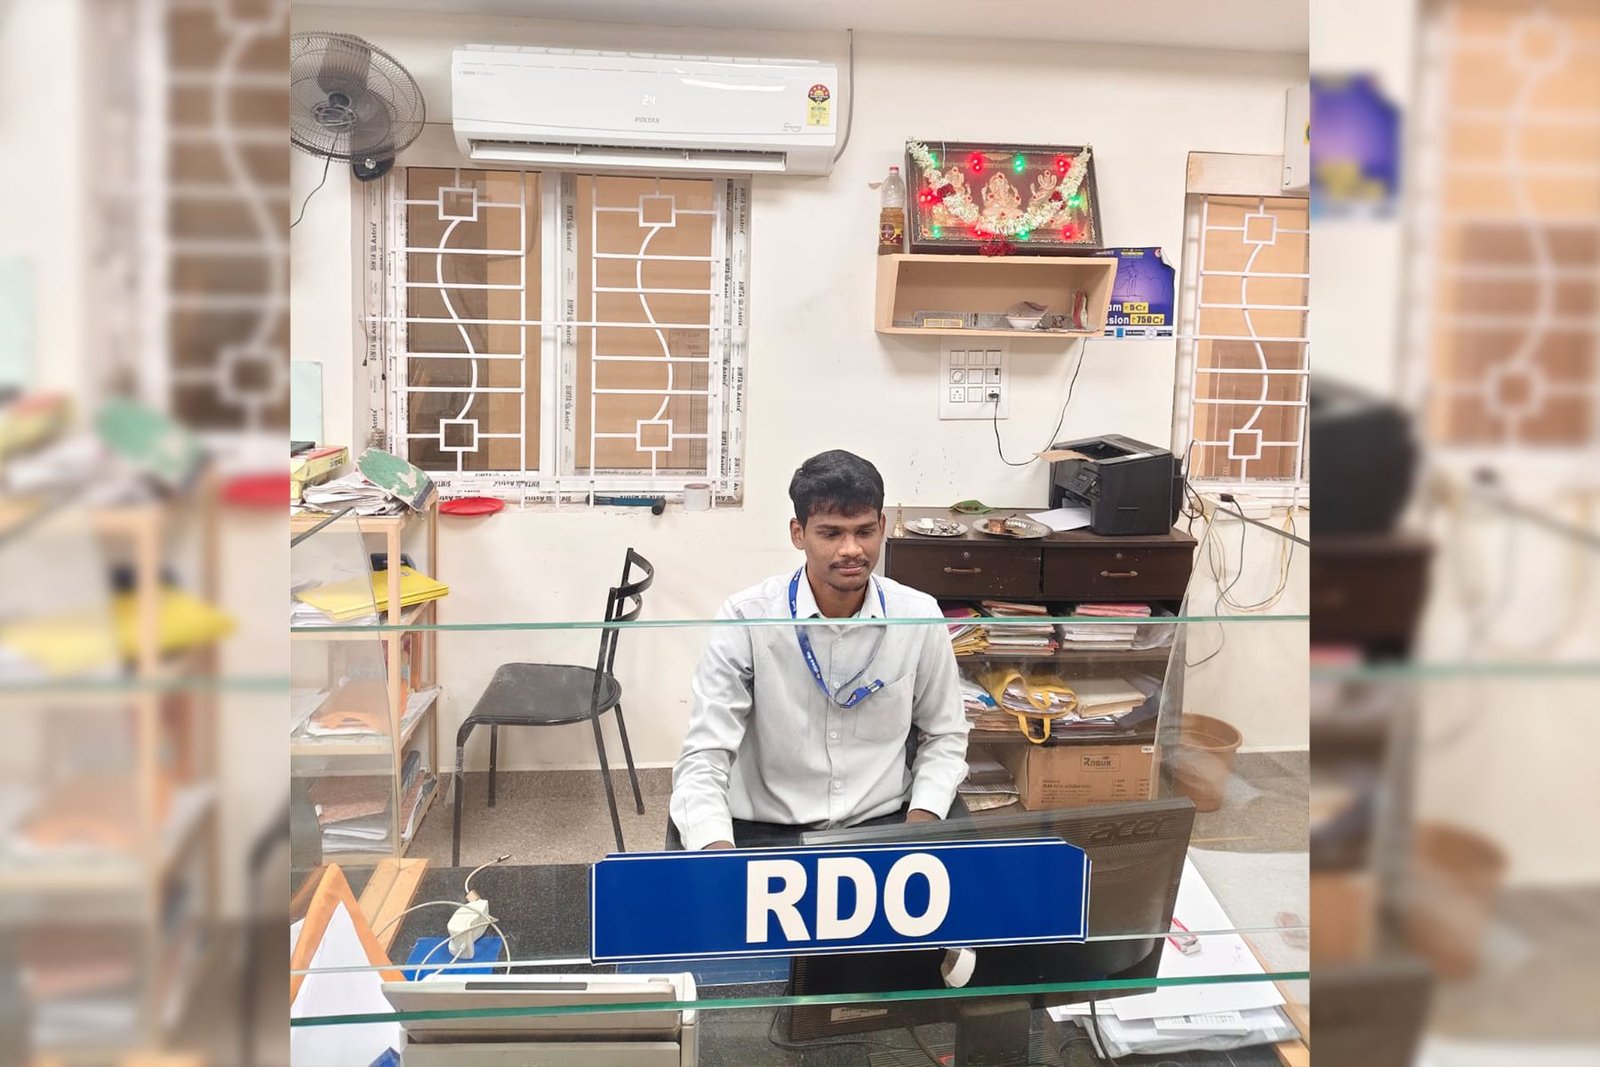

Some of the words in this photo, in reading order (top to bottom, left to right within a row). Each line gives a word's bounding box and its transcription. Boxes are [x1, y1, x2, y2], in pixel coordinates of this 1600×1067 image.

[641, 94, 657, 106] 24
[1090, 816, 1176, 842] acer
[746, 853, 951, 944] RDO
